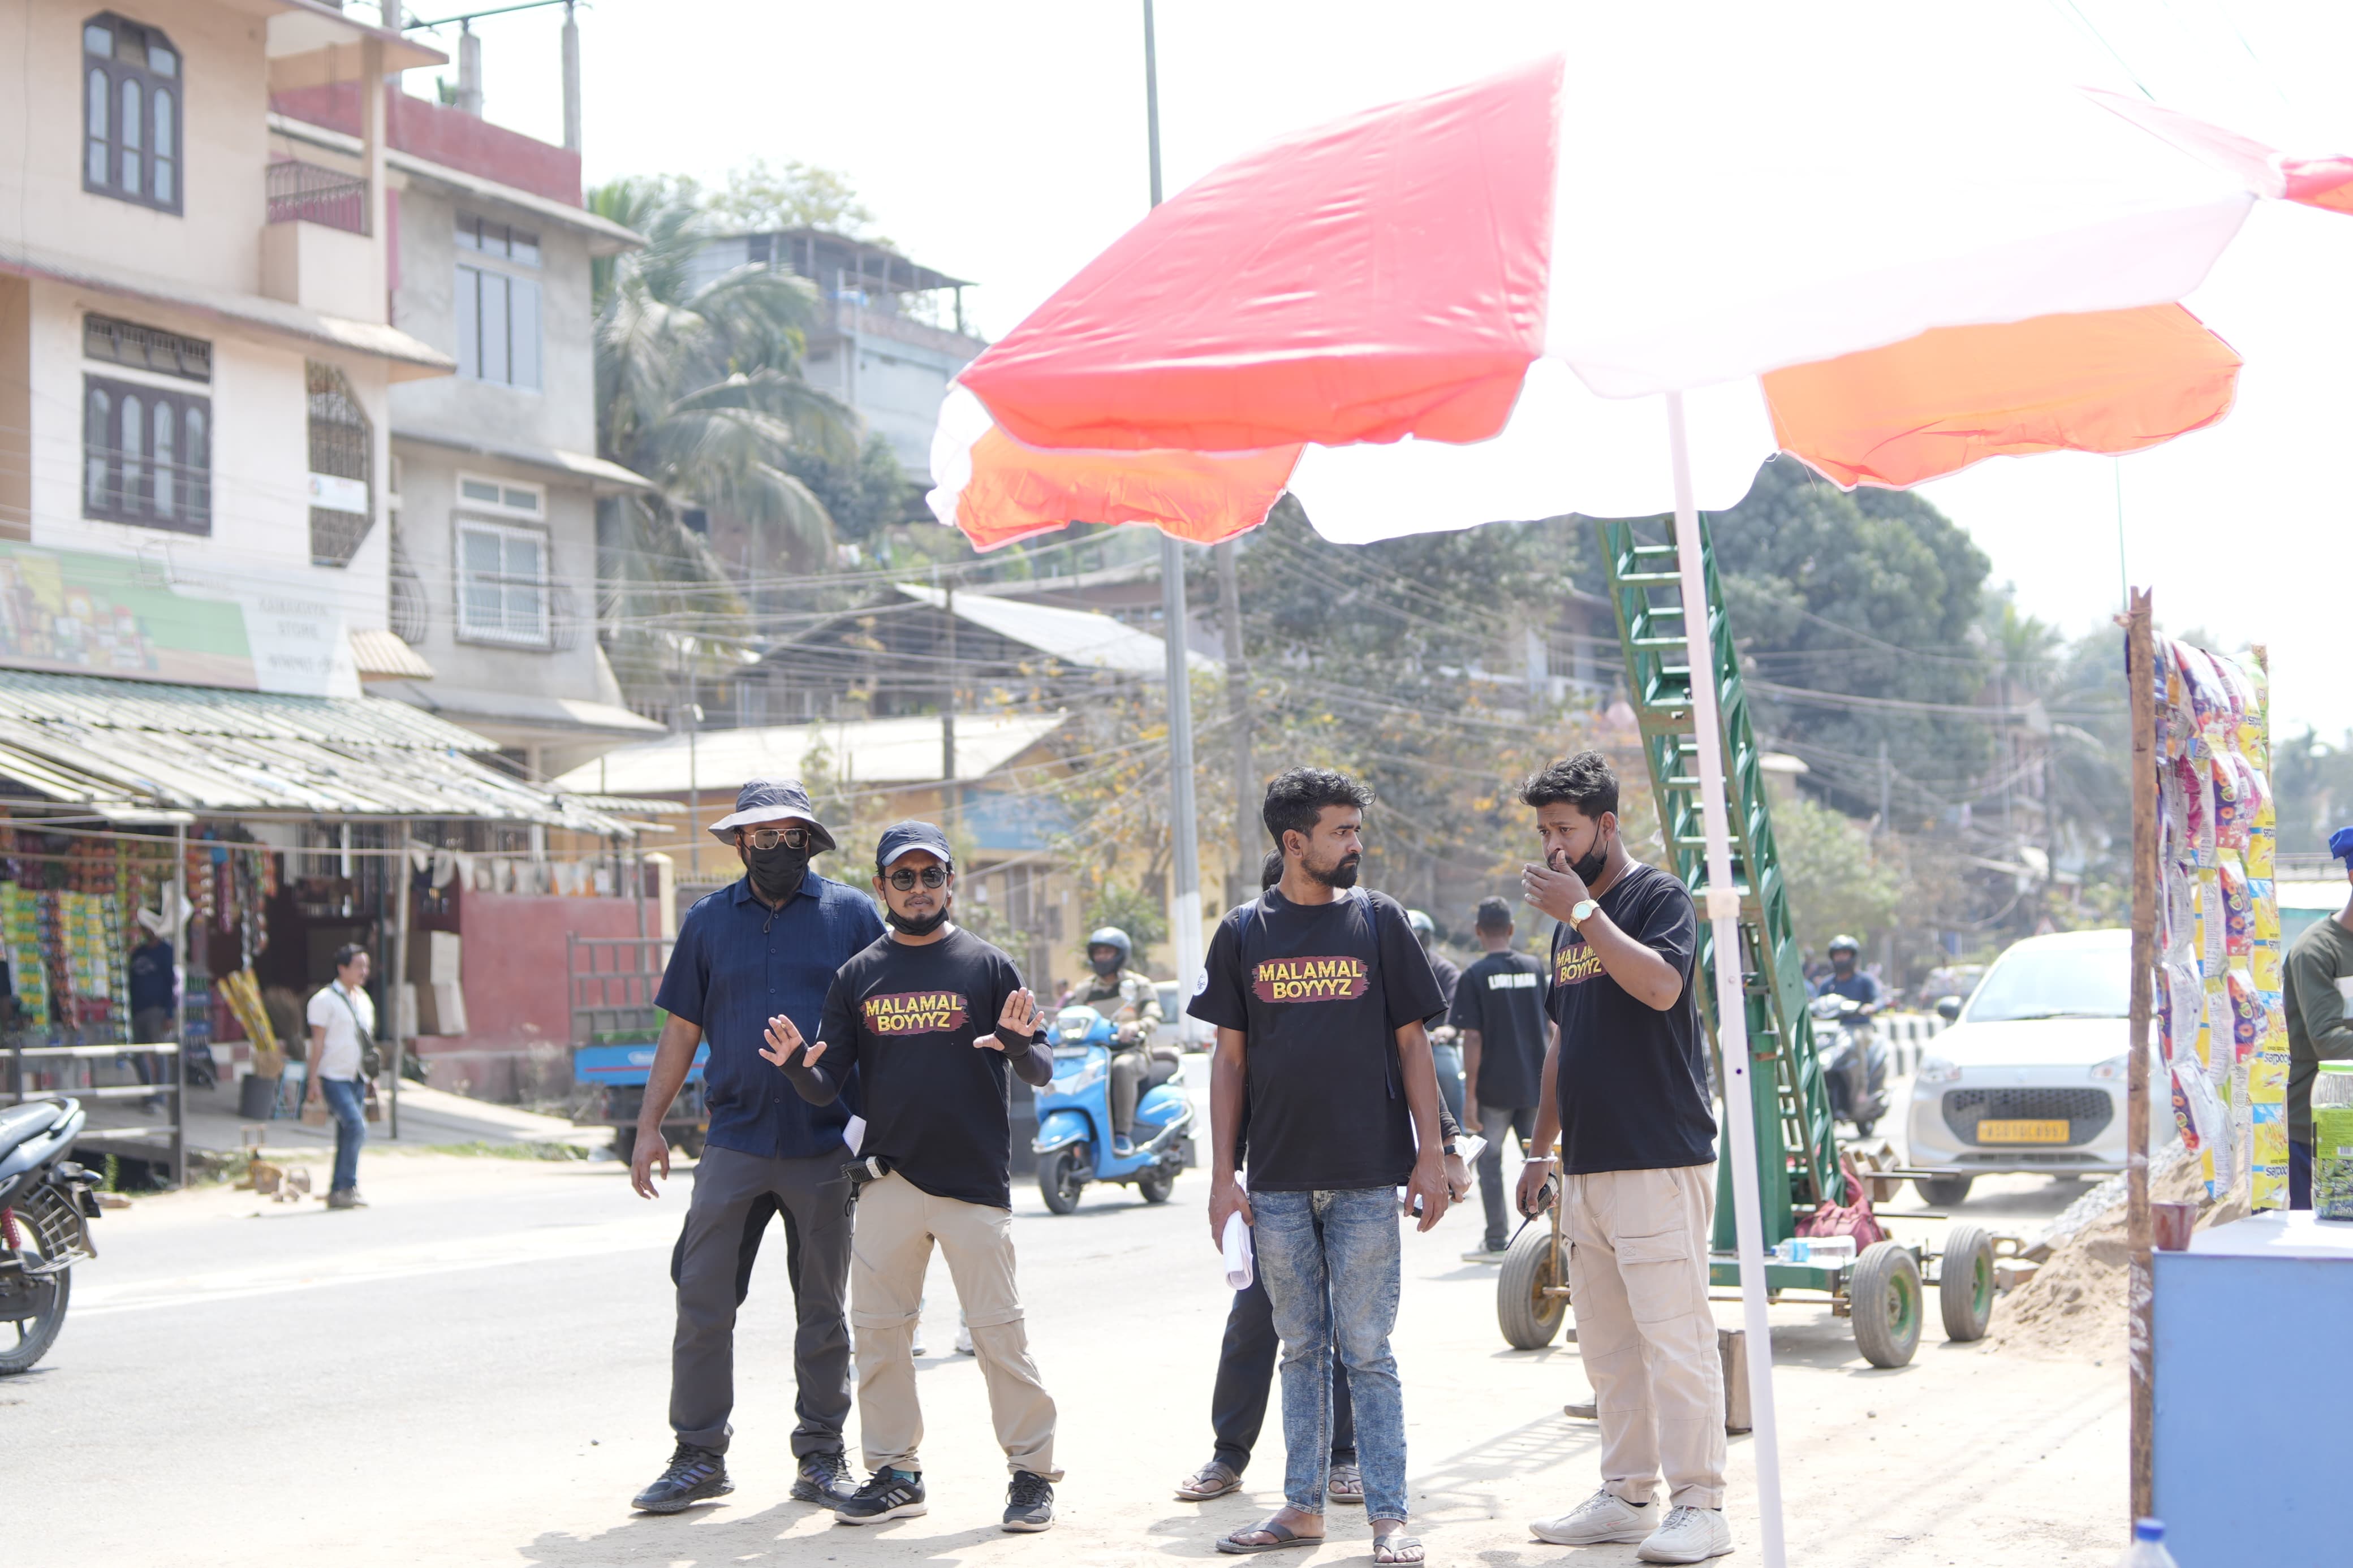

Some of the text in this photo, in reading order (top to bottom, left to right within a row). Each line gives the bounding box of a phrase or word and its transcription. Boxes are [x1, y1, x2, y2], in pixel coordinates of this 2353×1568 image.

[1556, 945, 1596, 969] MALAM
[1259, 960, 1363, 982] MALAMAL
[1560, 957, 1601, 983] BOYYYZ
[1273, 979, 1352, 999] BOYYYZ
[865, 995, 963, 1017] MALAMAL
[877, 1012, 951, 1032] BOYYYZ
